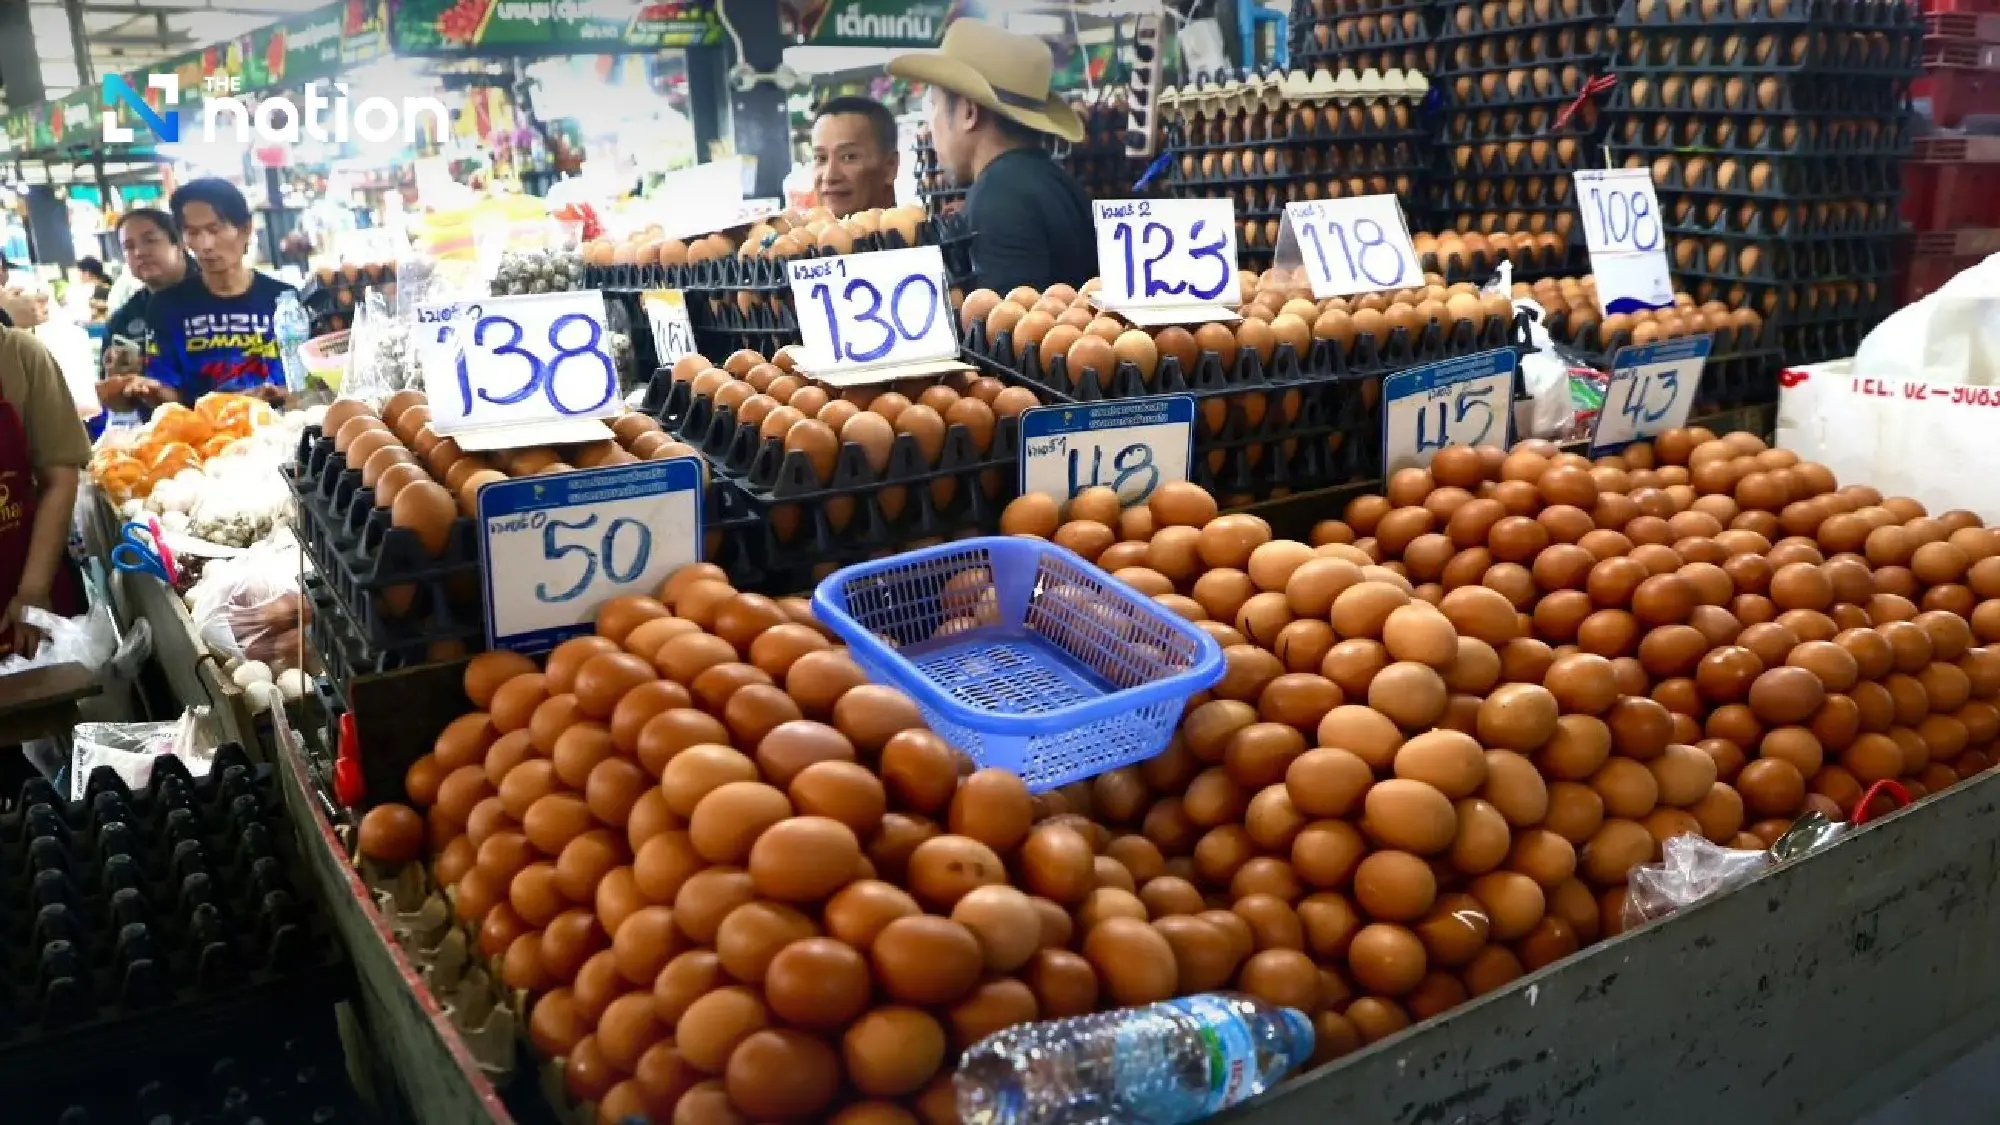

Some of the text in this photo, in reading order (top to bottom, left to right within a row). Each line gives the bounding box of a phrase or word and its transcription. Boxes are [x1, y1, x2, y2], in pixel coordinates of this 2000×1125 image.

[1138, 201, 1152, 217] 2
[1591, 188, 1658, 251] 108
[836, 259, 846, 277] 1
[1113, 220, 1230, 300] 123
[1302, 219, 1406, 287] 118
[184, 313, 270, 336] ISUZU
[811, 273, 938, 363] 130
[436, 313, 617, 417] 138
[1621, 369, 1679, 427] 43
[1416, 385, 1494, 454] 45
[1068, 442, 1159, 508] 48
[535, 512, 652, 603] 50
